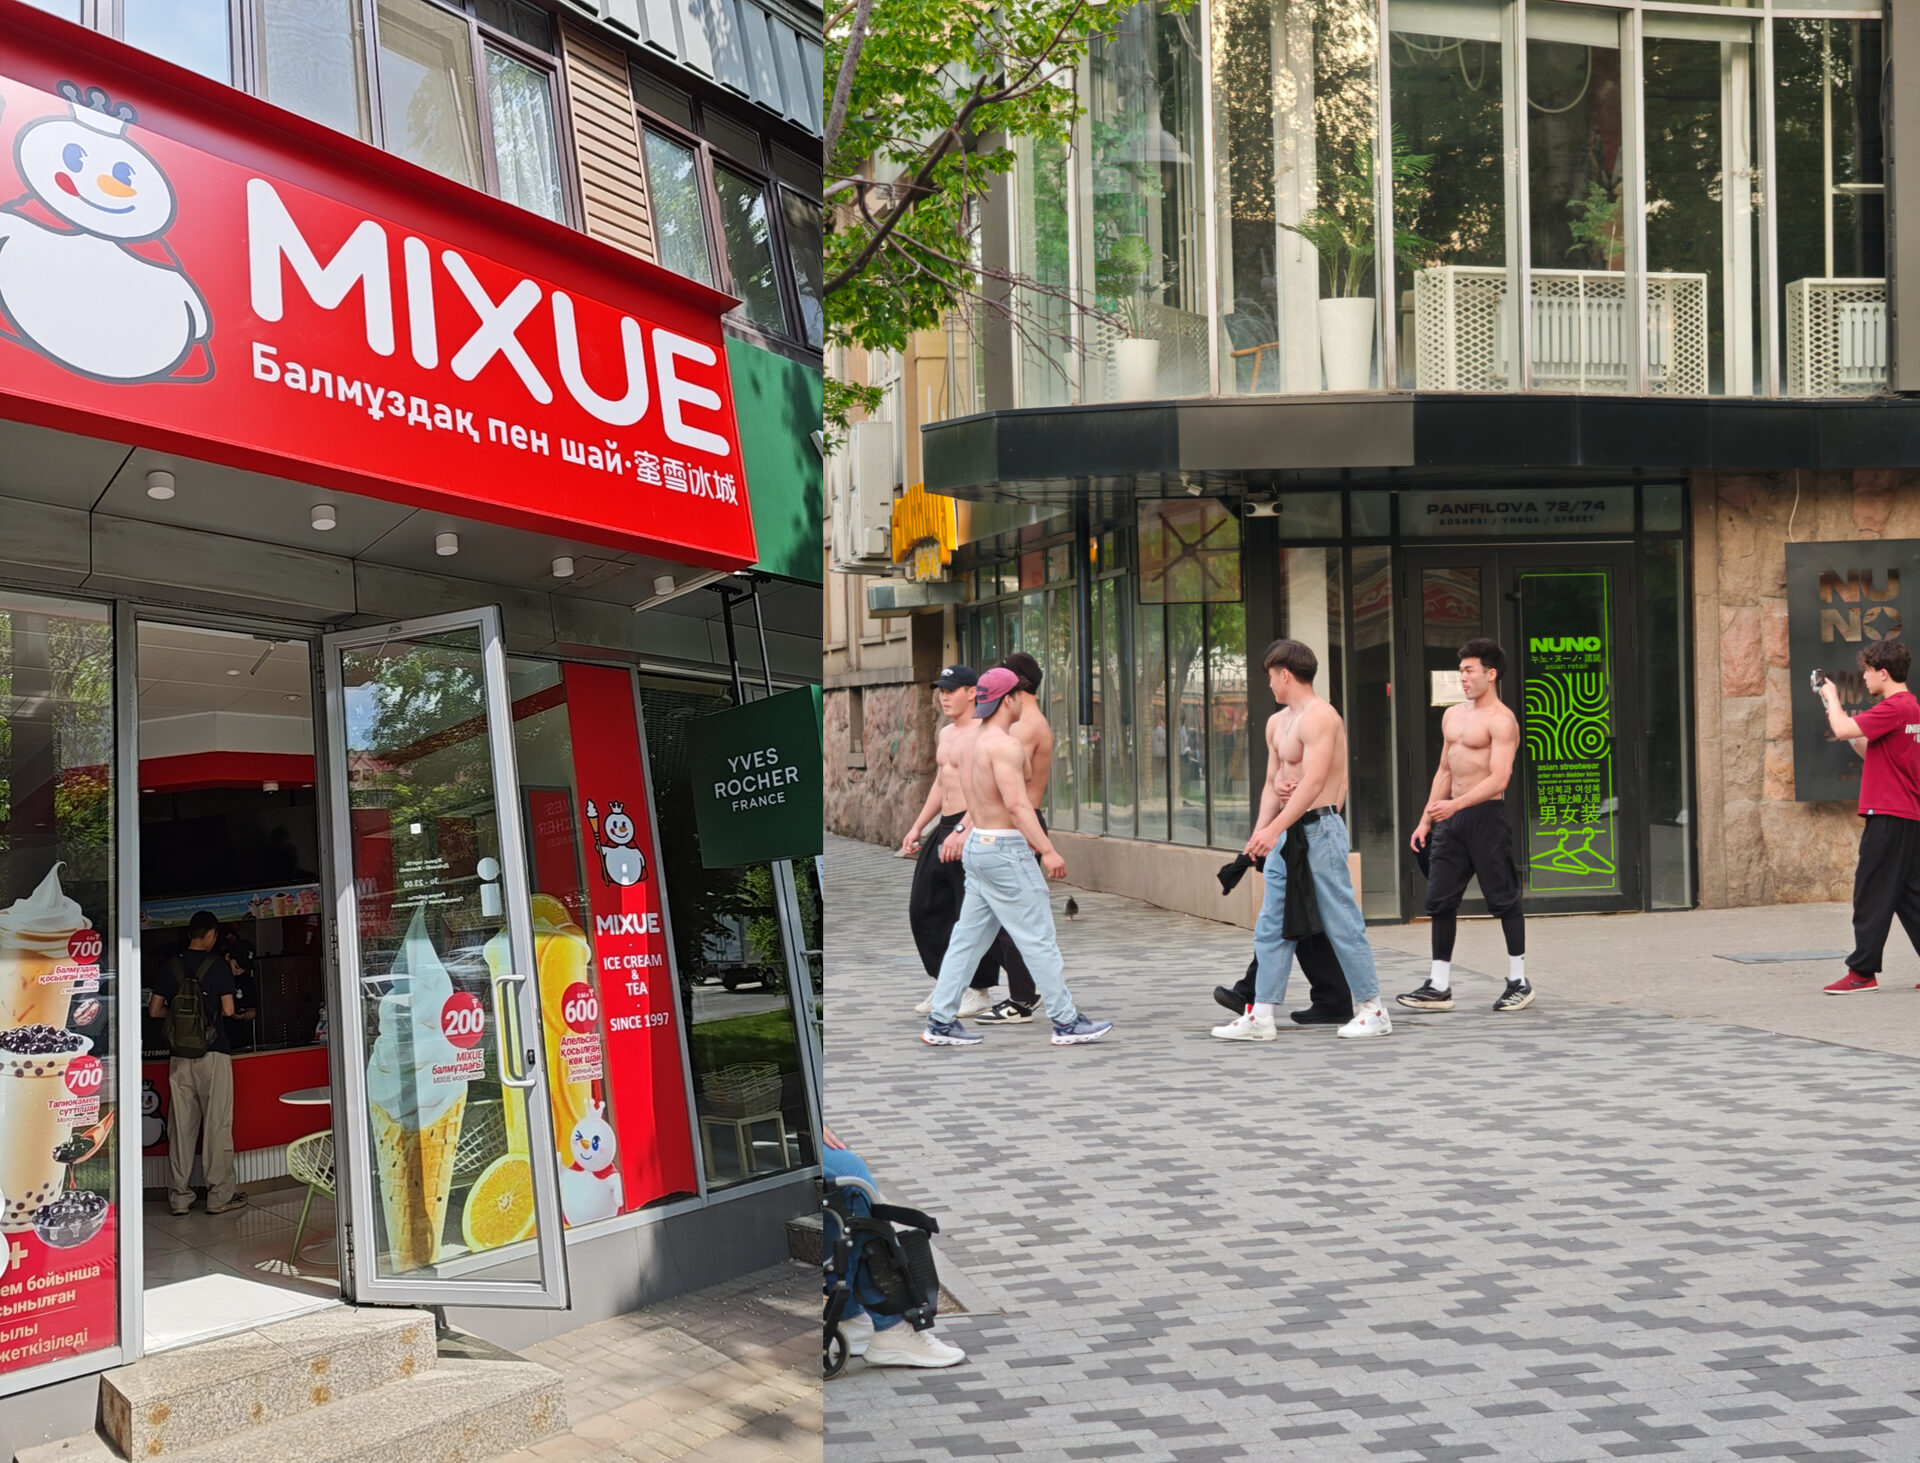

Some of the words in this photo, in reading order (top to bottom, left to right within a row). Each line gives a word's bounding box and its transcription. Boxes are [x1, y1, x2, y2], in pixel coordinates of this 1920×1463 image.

[247, 178, 730, 456] MIXUE
[252, 341, 481, 443] Балмұздақ
[488, 417, 549, 456] пен
[633, 450, 739, 506] 蜜雪冰城
[1427, 503, 1538, 515] PANFILOVA
[1546, 501, 1606, 514] 72/74
[1819, 568, 1900, 603] NU
[1530, 636, 1601, 653] NUNO
[727, 747, 779, 774] YVES
[714, 766, 799, 799] ROCHER
[732, 791, 786, 812] FRANCE
[1539, 803, 1602, 826] 男女装
[596, 912, 660, 936] MIXUE
[70, 940, 102, 957] 700
[603, 955, 621, 970] ICE
[623, 953, 663, 968] CREAM
[631, 969, 639, 980] &
[625, 981, 648, 996] TEA
[564, 998, 599, 1023] 600
[444, 1008, 485, 1036] 200
[610, 1015, 642, 1032] SINCE
[645, 1012, 670, 1028] 1997
[561, 1035, 600, 1046] Апельсин
[456, 1050, 483, 1062] MIXUE
[560, 1045, 600, 1058] қосылған
[68, 1068, 103, 1089] 700
[27, 1265, 100, 1292] бойынша
[0, 1327, 88, 1364] жеткізіледі
